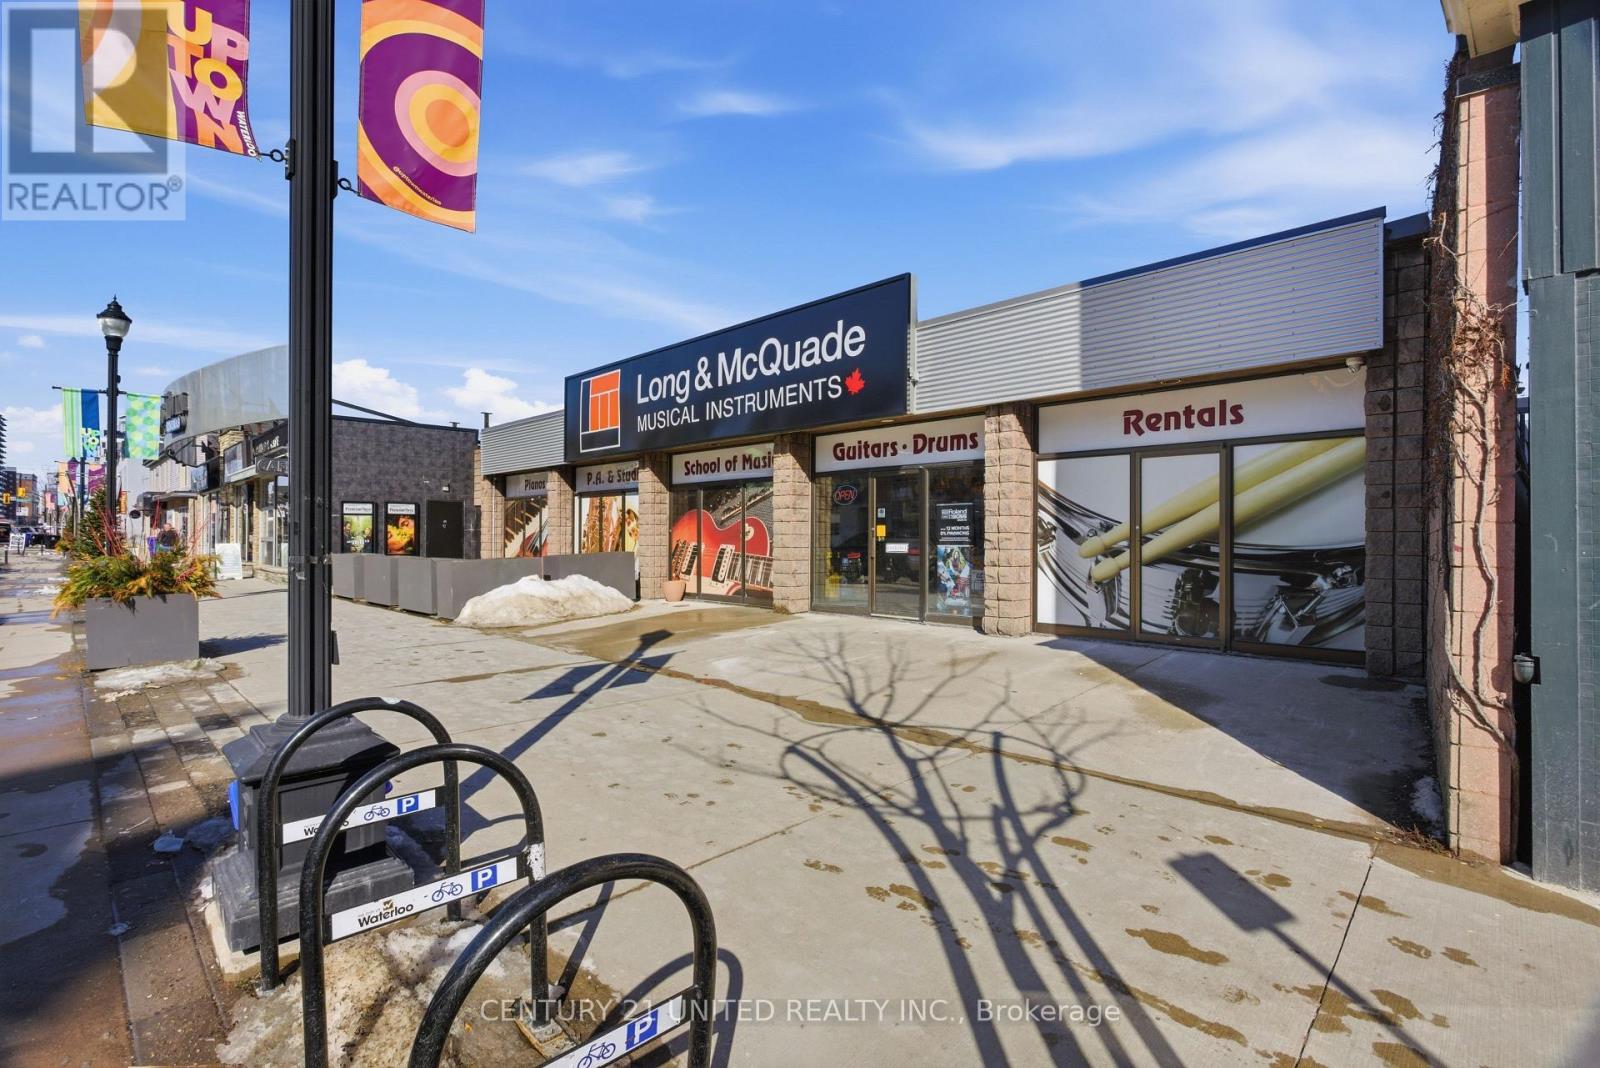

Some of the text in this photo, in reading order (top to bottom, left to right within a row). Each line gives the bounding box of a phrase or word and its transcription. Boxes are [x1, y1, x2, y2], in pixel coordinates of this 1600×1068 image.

[236, 110, 257, 157] WATERLOO
[637, 320, 866, 404] Long & McQuade
[637, 375, 842, 433] MUSICAL INSTRUMENTS
[1122, 399, 1245, 437] Rentals
[833, 432, 979, 462] Guitars Drums
[587, 472, 604, 486] P.A.
[607, 470, 614, 484] &
[684, 457, 720, 476] School
[725, 455, 738, 472] of
[524, 479, 546, 491] Pianos
[835, 489, 855, 501] OPEN
[358, 904, 414, 928] Waterloo
